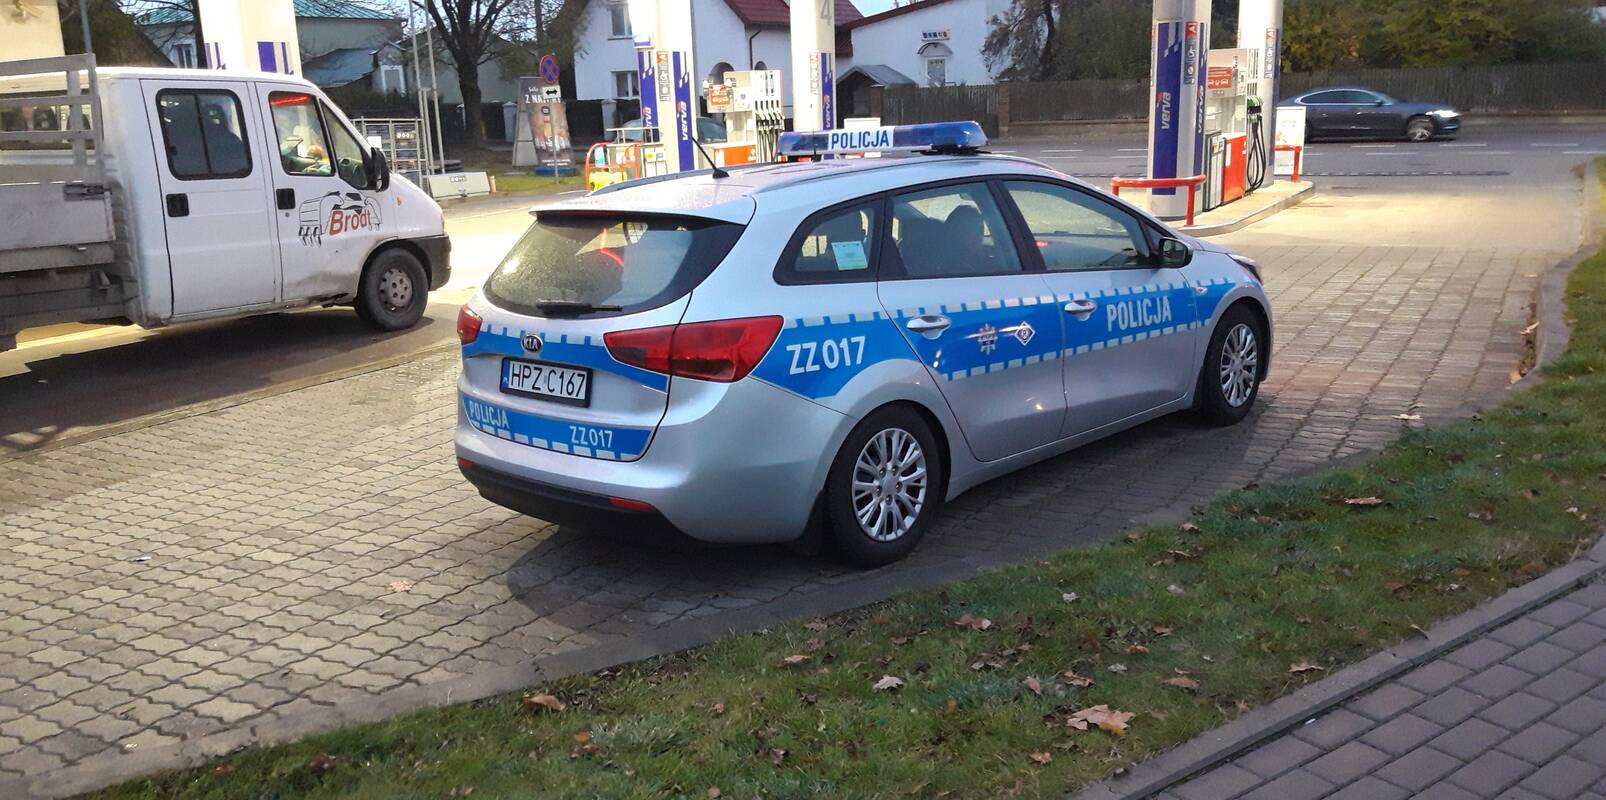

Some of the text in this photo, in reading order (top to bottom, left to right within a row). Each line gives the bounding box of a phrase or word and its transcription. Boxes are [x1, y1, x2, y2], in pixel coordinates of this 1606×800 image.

[679, 101, 688, 140] verva
[1161, 92, 1171, 129] verva
[831, 130, 889, 149] POLICJA
[329, 209, 371, 235] Brodt
[1106, 296, 1172, 332] POLICJA
[523, 337, 539, 350] KIA
[511, 363, 586, 397] HPZ C167
[469, 400, 510, 428] POLICJA
